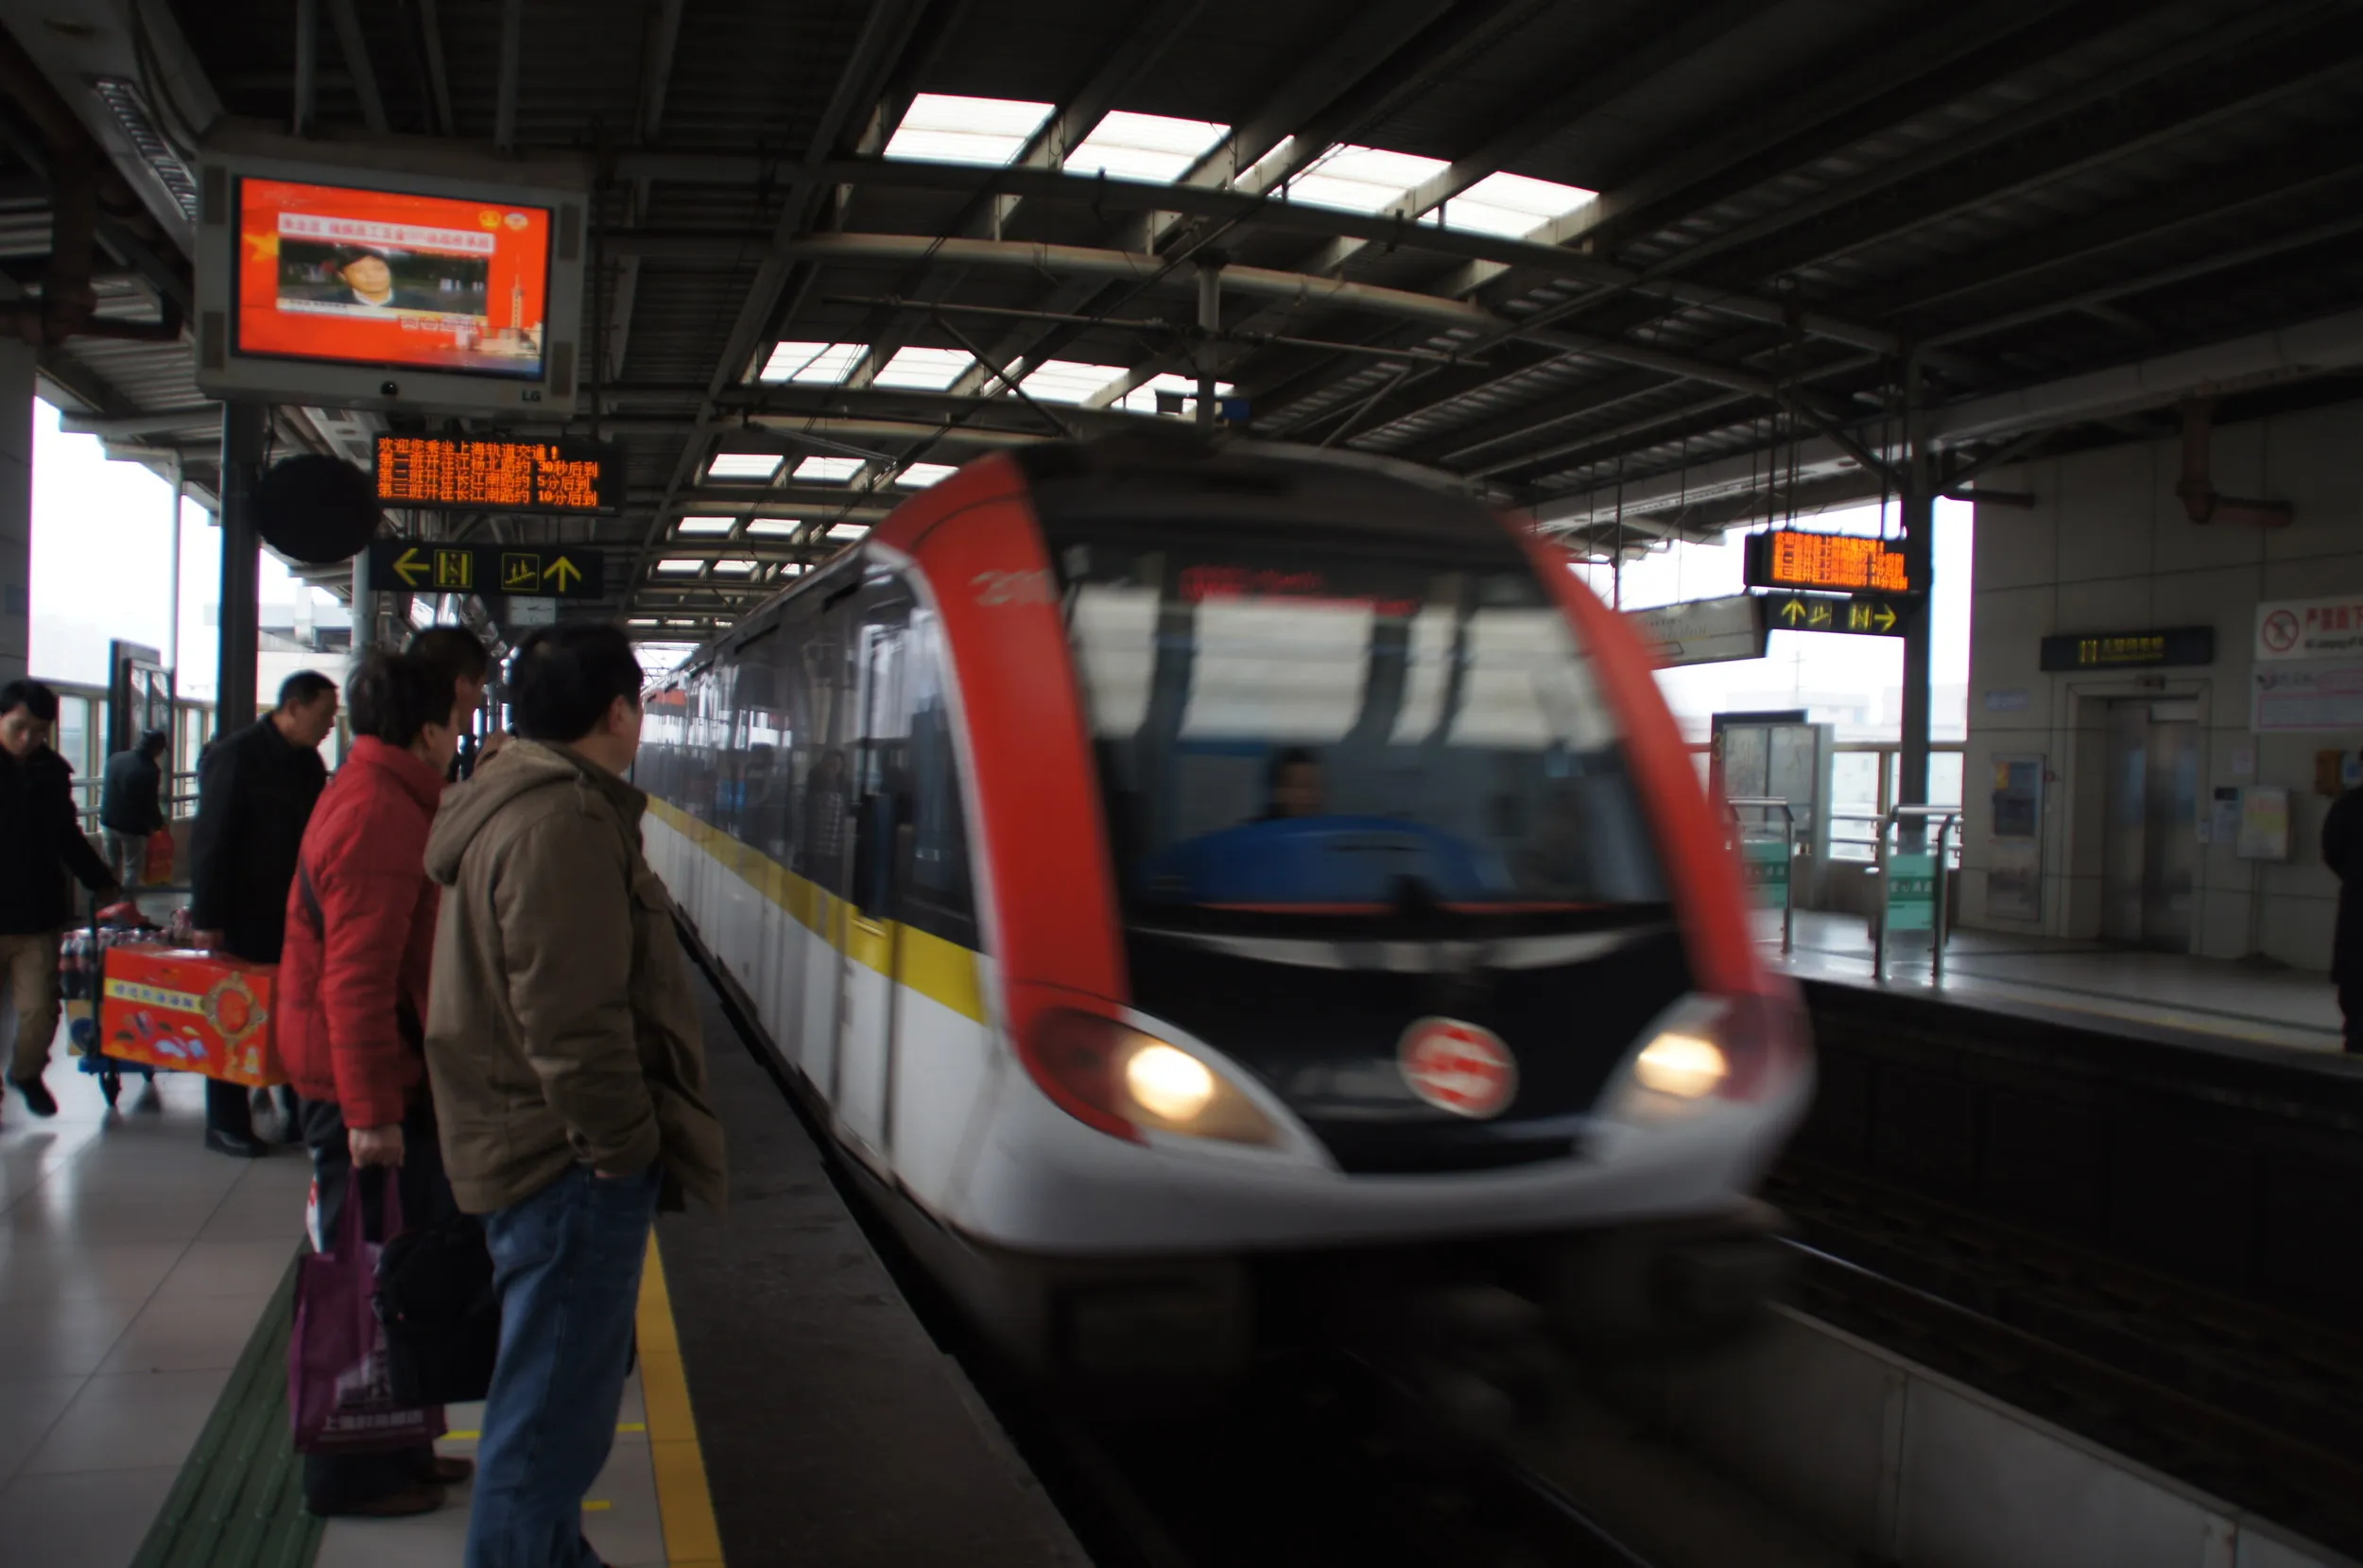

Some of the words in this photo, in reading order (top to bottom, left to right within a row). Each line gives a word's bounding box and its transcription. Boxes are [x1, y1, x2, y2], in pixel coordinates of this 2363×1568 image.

[522, 388, 542, 402] LG
[537, 460, 598, 477] 30秒后到
[537, 474, 591, 491] 5分后到
[537, 490, 597, 507] 10分后到
